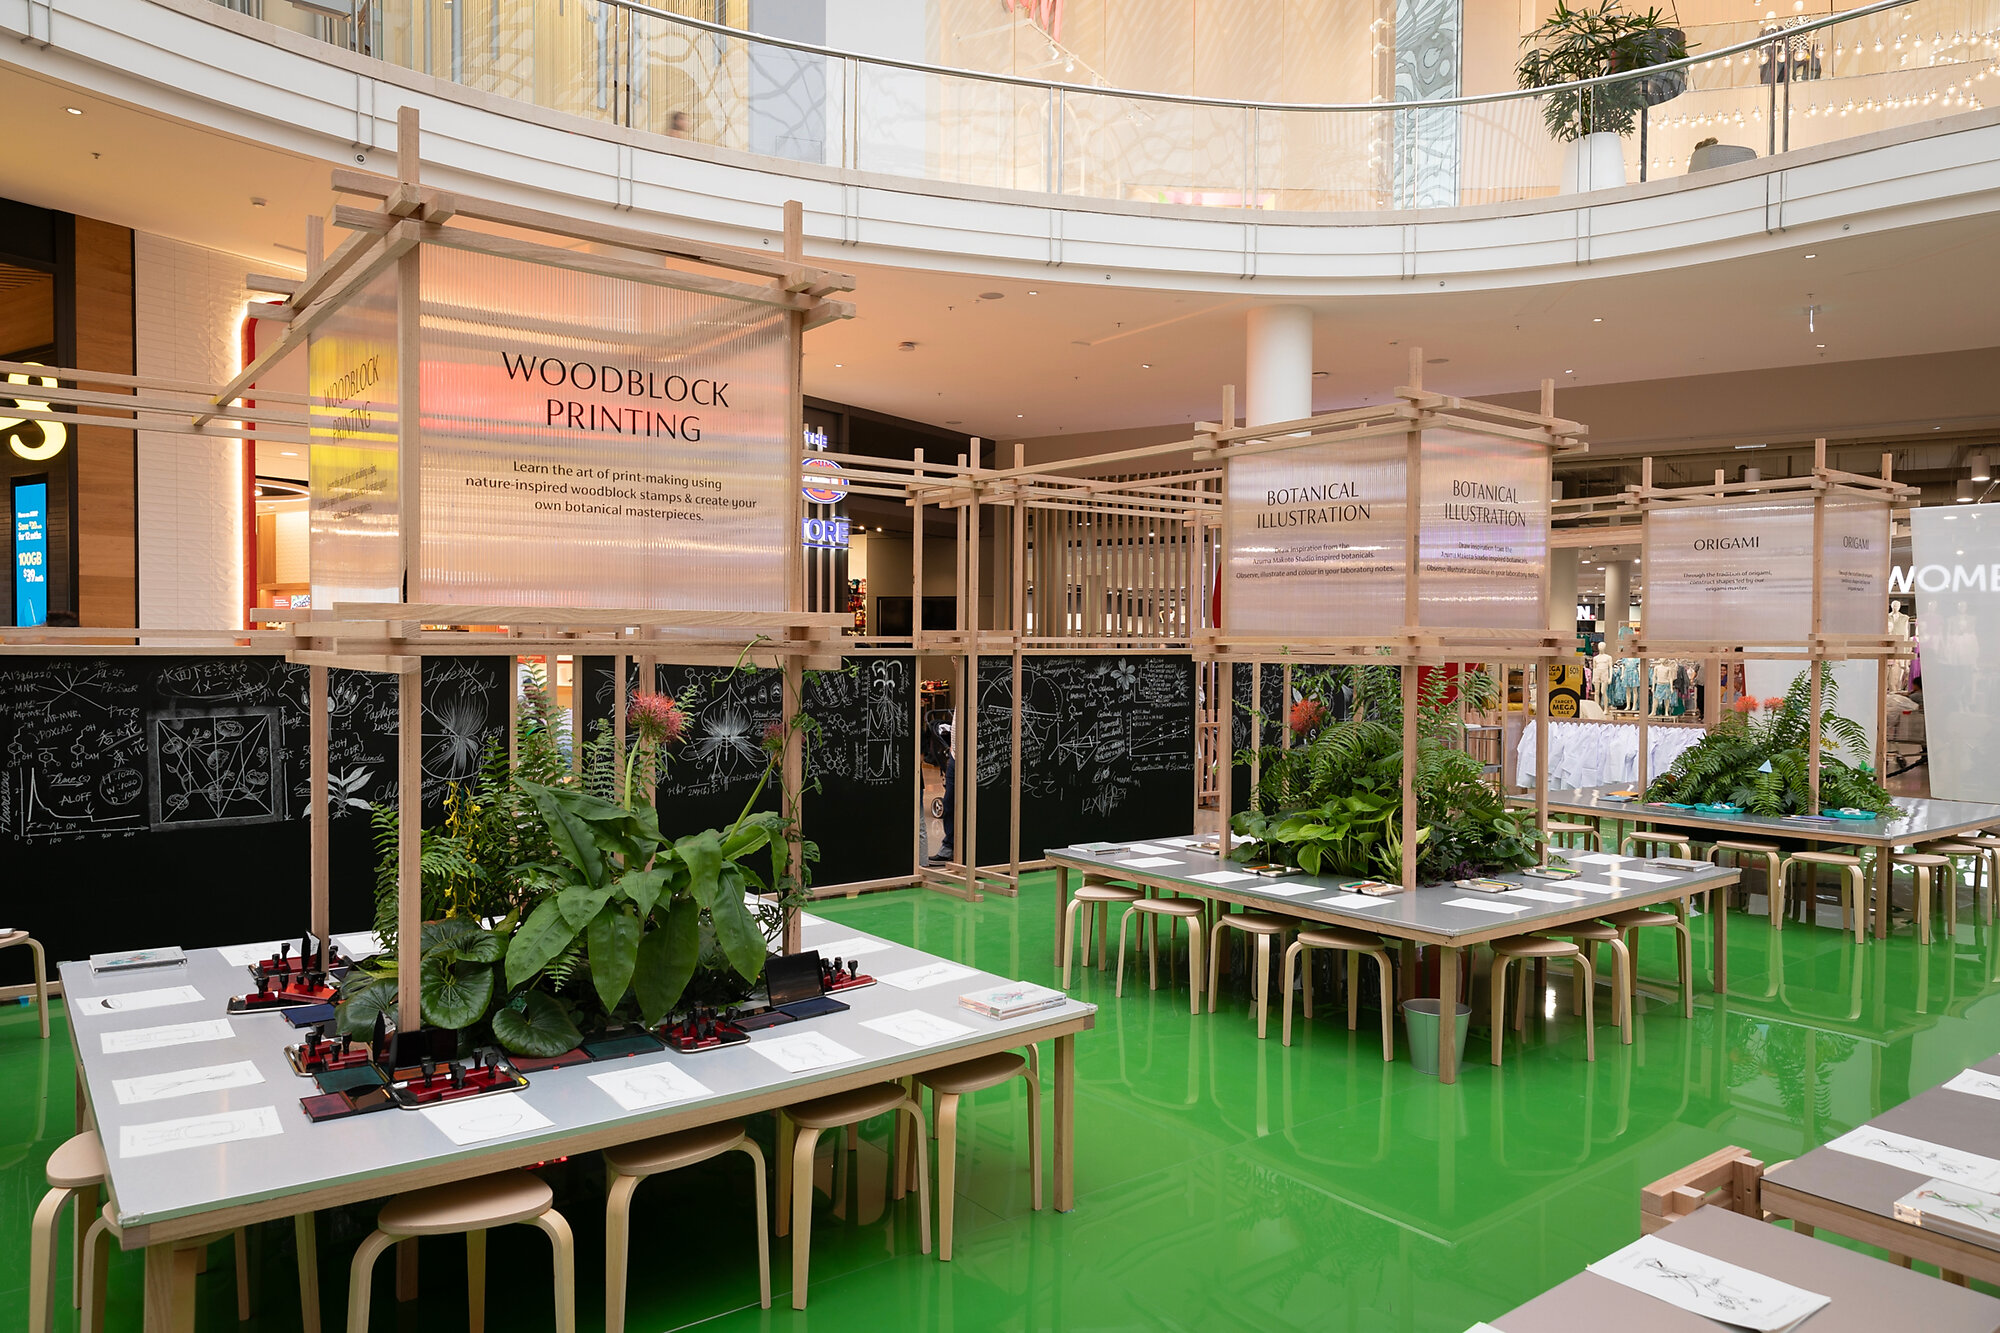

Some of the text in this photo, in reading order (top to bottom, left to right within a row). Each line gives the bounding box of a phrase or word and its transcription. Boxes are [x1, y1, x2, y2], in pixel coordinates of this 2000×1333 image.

[323, 354, 379, 411] WOODBLOCK
[501, 351, 729, 408] WOODBLOCK
[332, 401, 371, 444] PRINTING
[547, 399, 701, 442] PRINTING
[804, 430, 828, 448] THE
[513, 460, 722, 492] Learn the art of print-making using
[465, 476, 757, 509] nature-inspired woodblock stamps & create your
[1267, 481, 1359, 506] BOTANICAL
[1453, 479, 1518, 504] BOTANICAL
[534, 500, 704, 521] own botanical masterpieces.
[1256, 503, 1371, 529] ILLUSTRATION
[1444, 502, 1526, 527] ILLUSTRATION
[1693, 536, 1759, 551] ORIGAMI
[1842, 535, 1870, 550] ORIGAMI
[18, 551, 42, 566] 100GB
[1295, 555, 1315, 563] Studio
[1315, 553, 1340, 562] inspired
[1298, 568, 1317, 576] colour
[1324, 568, 1339, 576] your
[1340, 566, 1374, 575] laboratory
